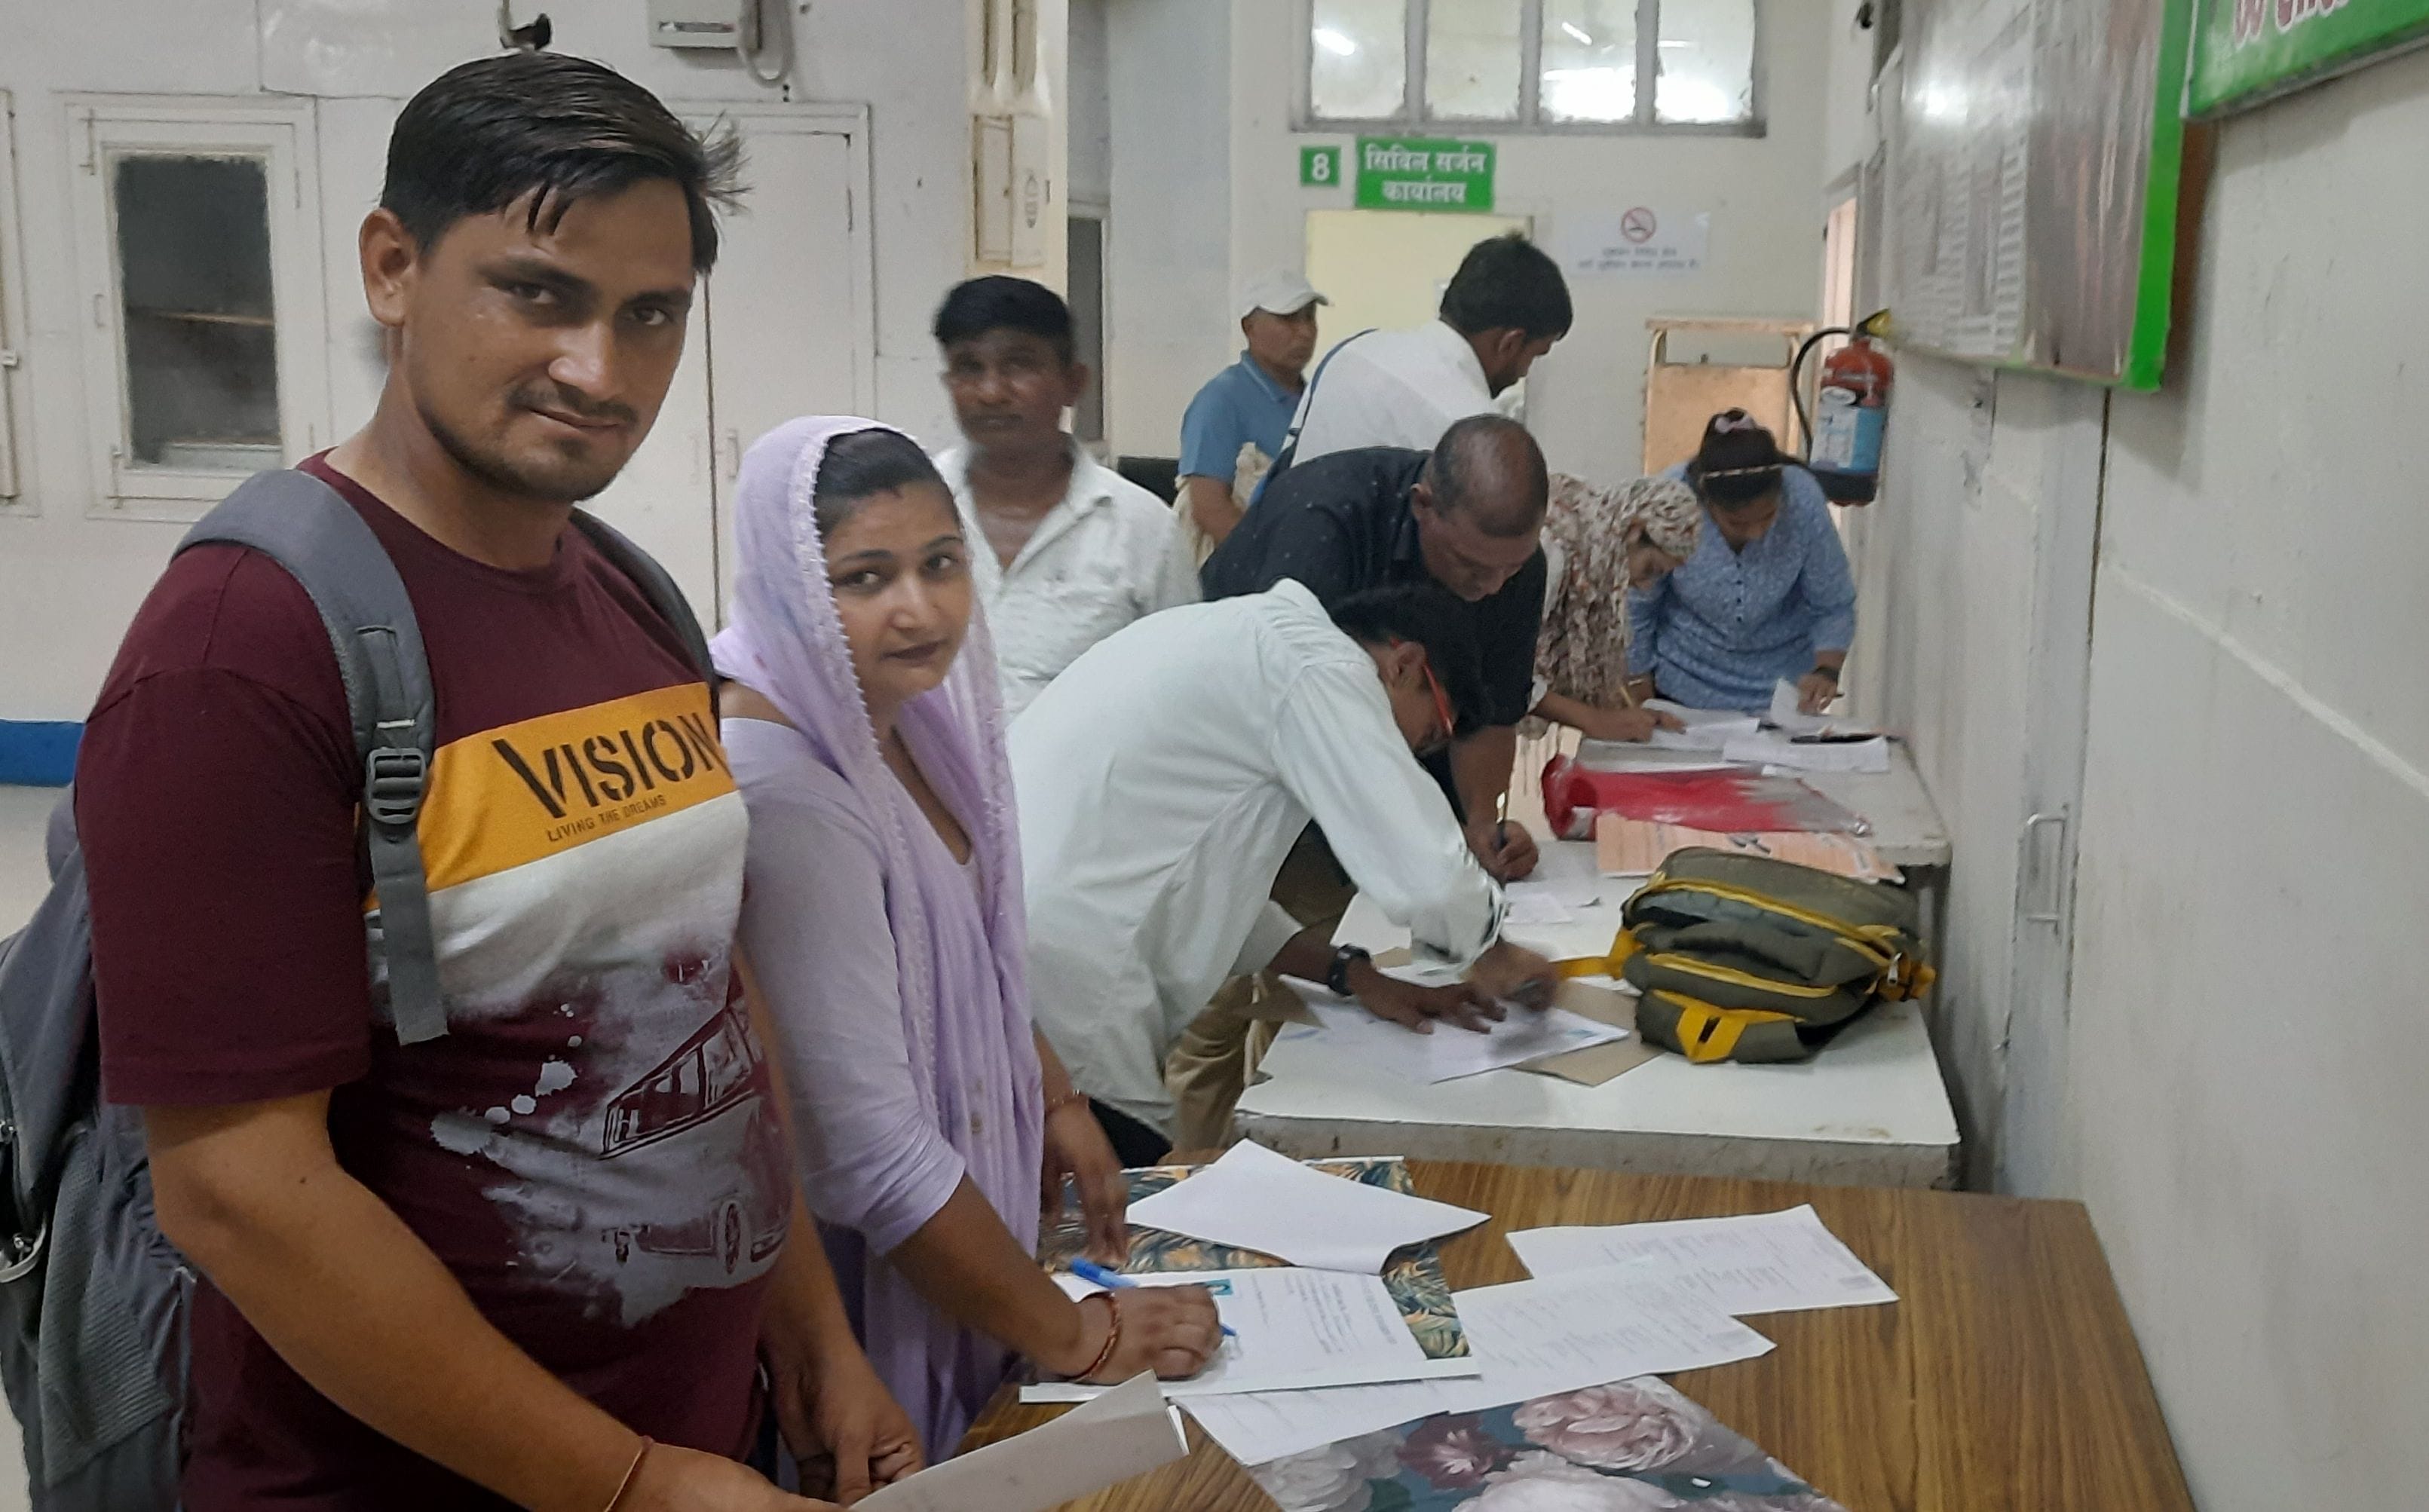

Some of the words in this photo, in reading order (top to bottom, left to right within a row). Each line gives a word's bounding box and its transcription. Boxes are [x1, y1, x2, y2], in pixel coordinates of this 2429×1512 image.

[1313, 153, 1330, 181] 8
[1365, 143, 1430, 171] सिविल
[1435, 145, 1487, 173] सर्जन
[1382, 175, 1467, 203] कार्यालय
[492, 712, 733, 818] VISION
[547, 818, 595, 842] LIVING
[599, 809, 620, 825] THE
[623, 794, 666, 817] DREAMS
